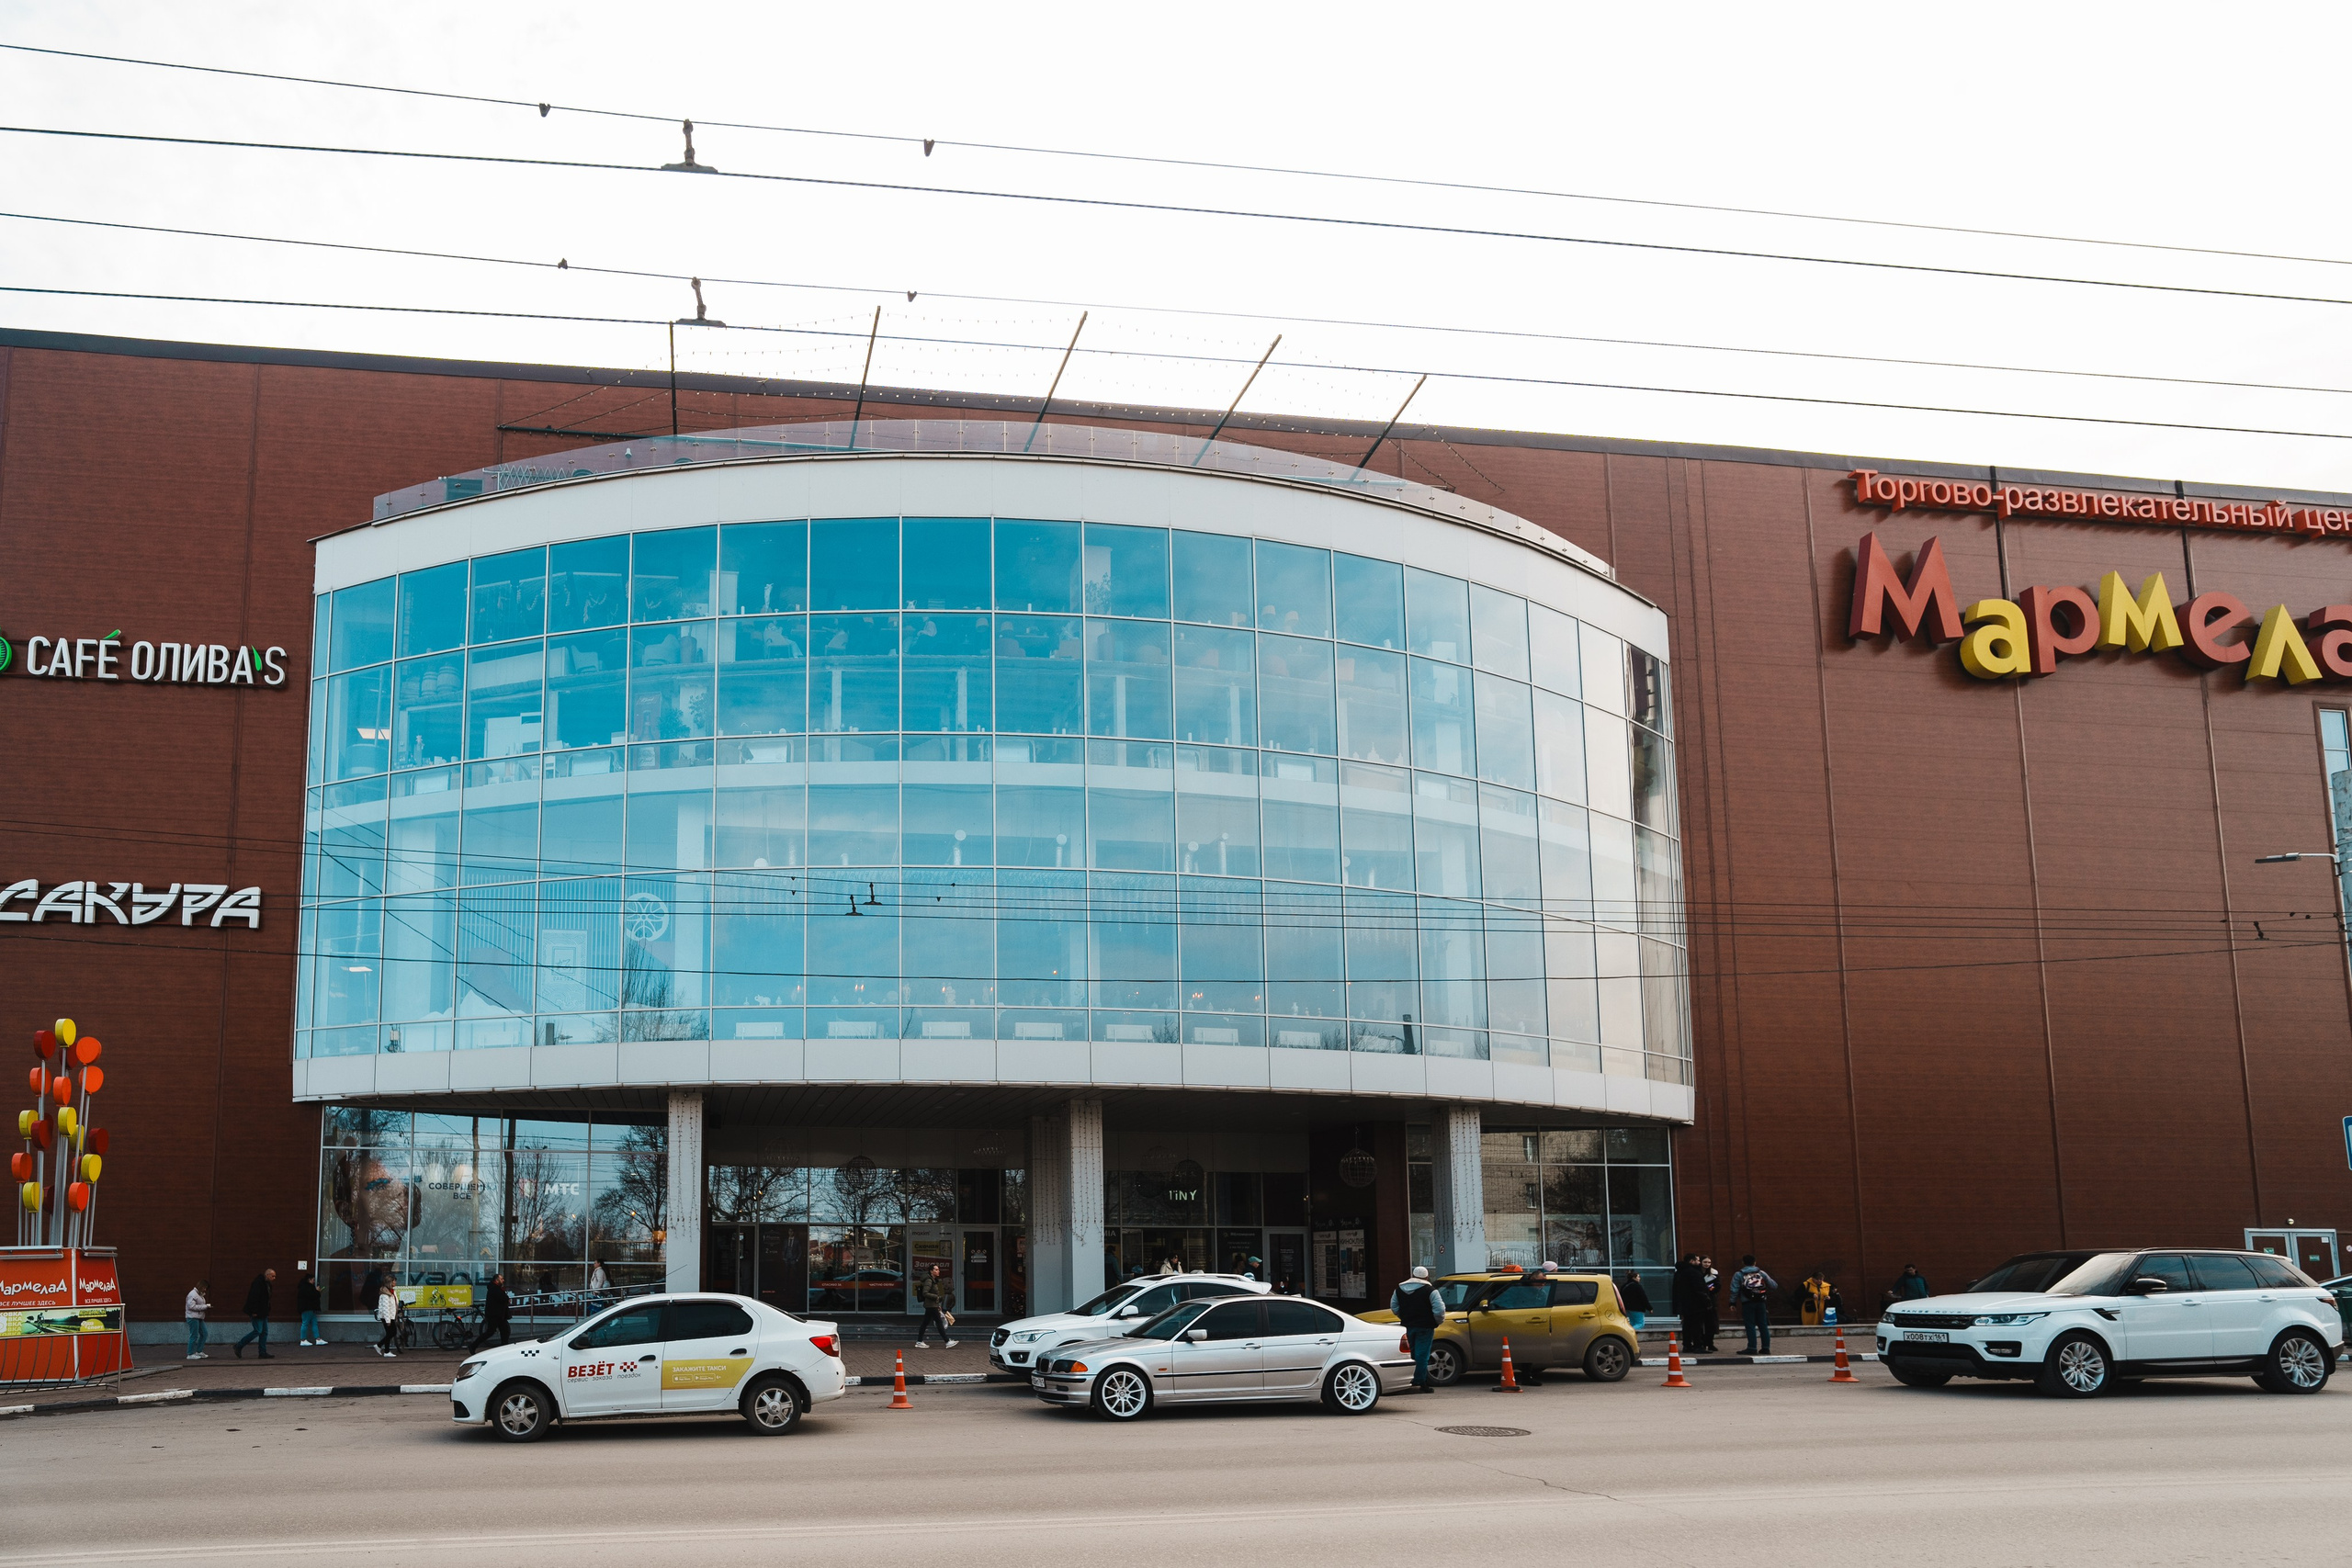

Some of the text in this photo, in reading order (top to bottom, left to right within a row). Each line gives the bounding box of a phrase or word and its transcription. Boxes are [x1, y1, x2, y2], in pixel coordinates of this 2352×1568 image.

[1848, 468, 2294, 529] Торгово-развлекательный
[544, 1182, 580, 1196] МТС
[567, 1360, 616, 1379] ВЕЗЁТ
